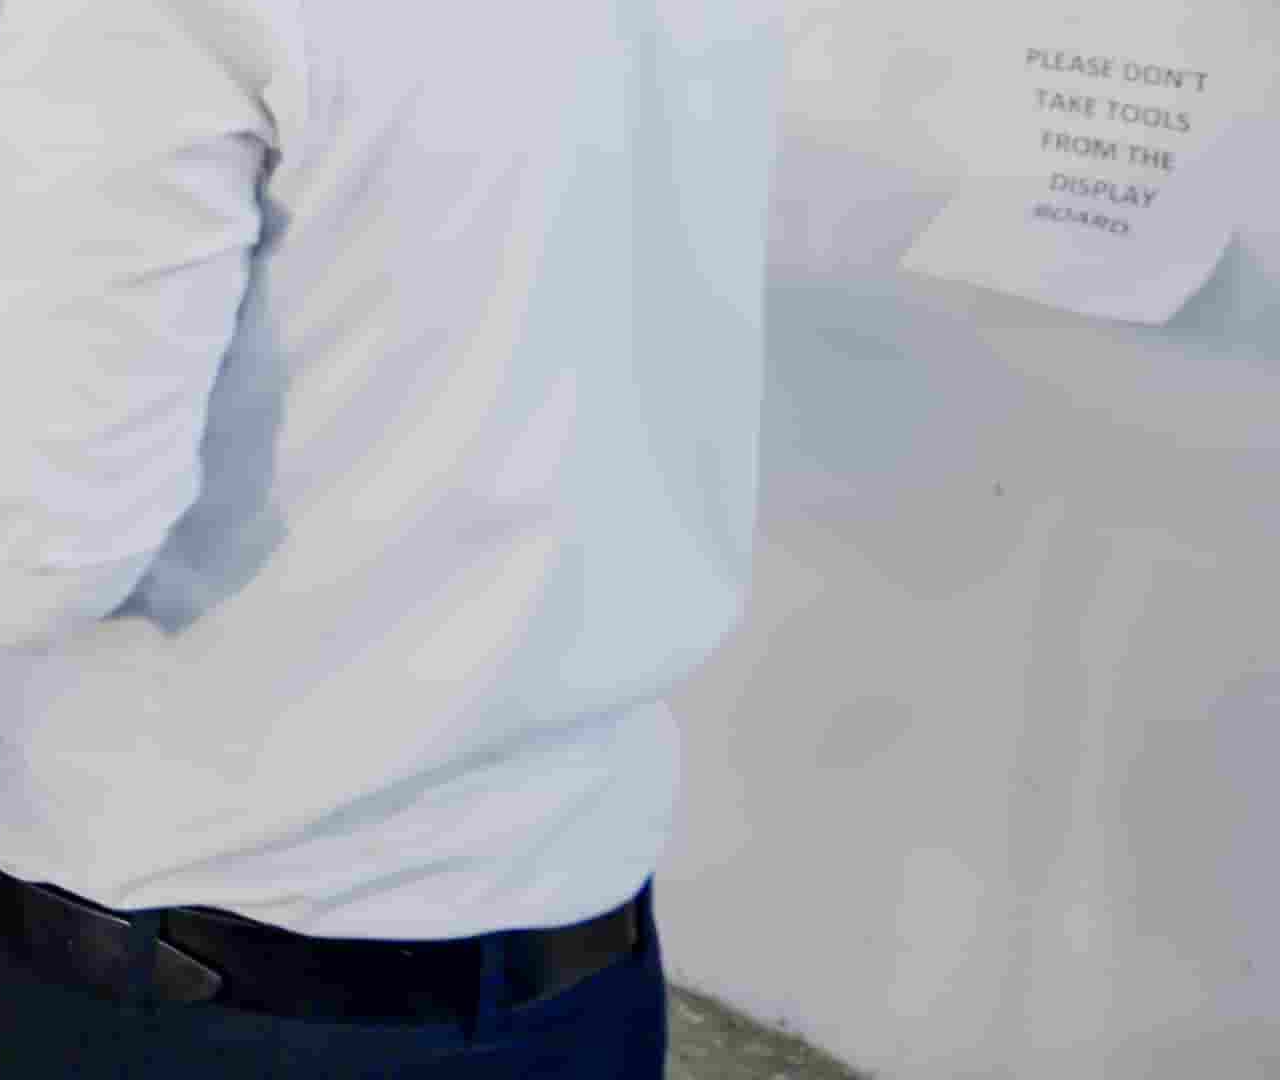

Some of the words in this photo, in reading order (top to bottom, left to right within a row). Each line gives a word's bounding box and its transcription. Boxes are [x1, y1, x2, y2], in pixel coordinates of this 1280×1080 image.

[1025, 47, 1114, 78] PLEASE
[1122, 61, 1208, 92] DON'T
[1034, 88, 1096, 119] TAKE
[1107, 99, 1191, 133] TOOLS
[1041, 128, 1117, 160] FROM
[1128, 144, 1175, 174] THE
[1049, 172, 1159, 208] DISPLAY
